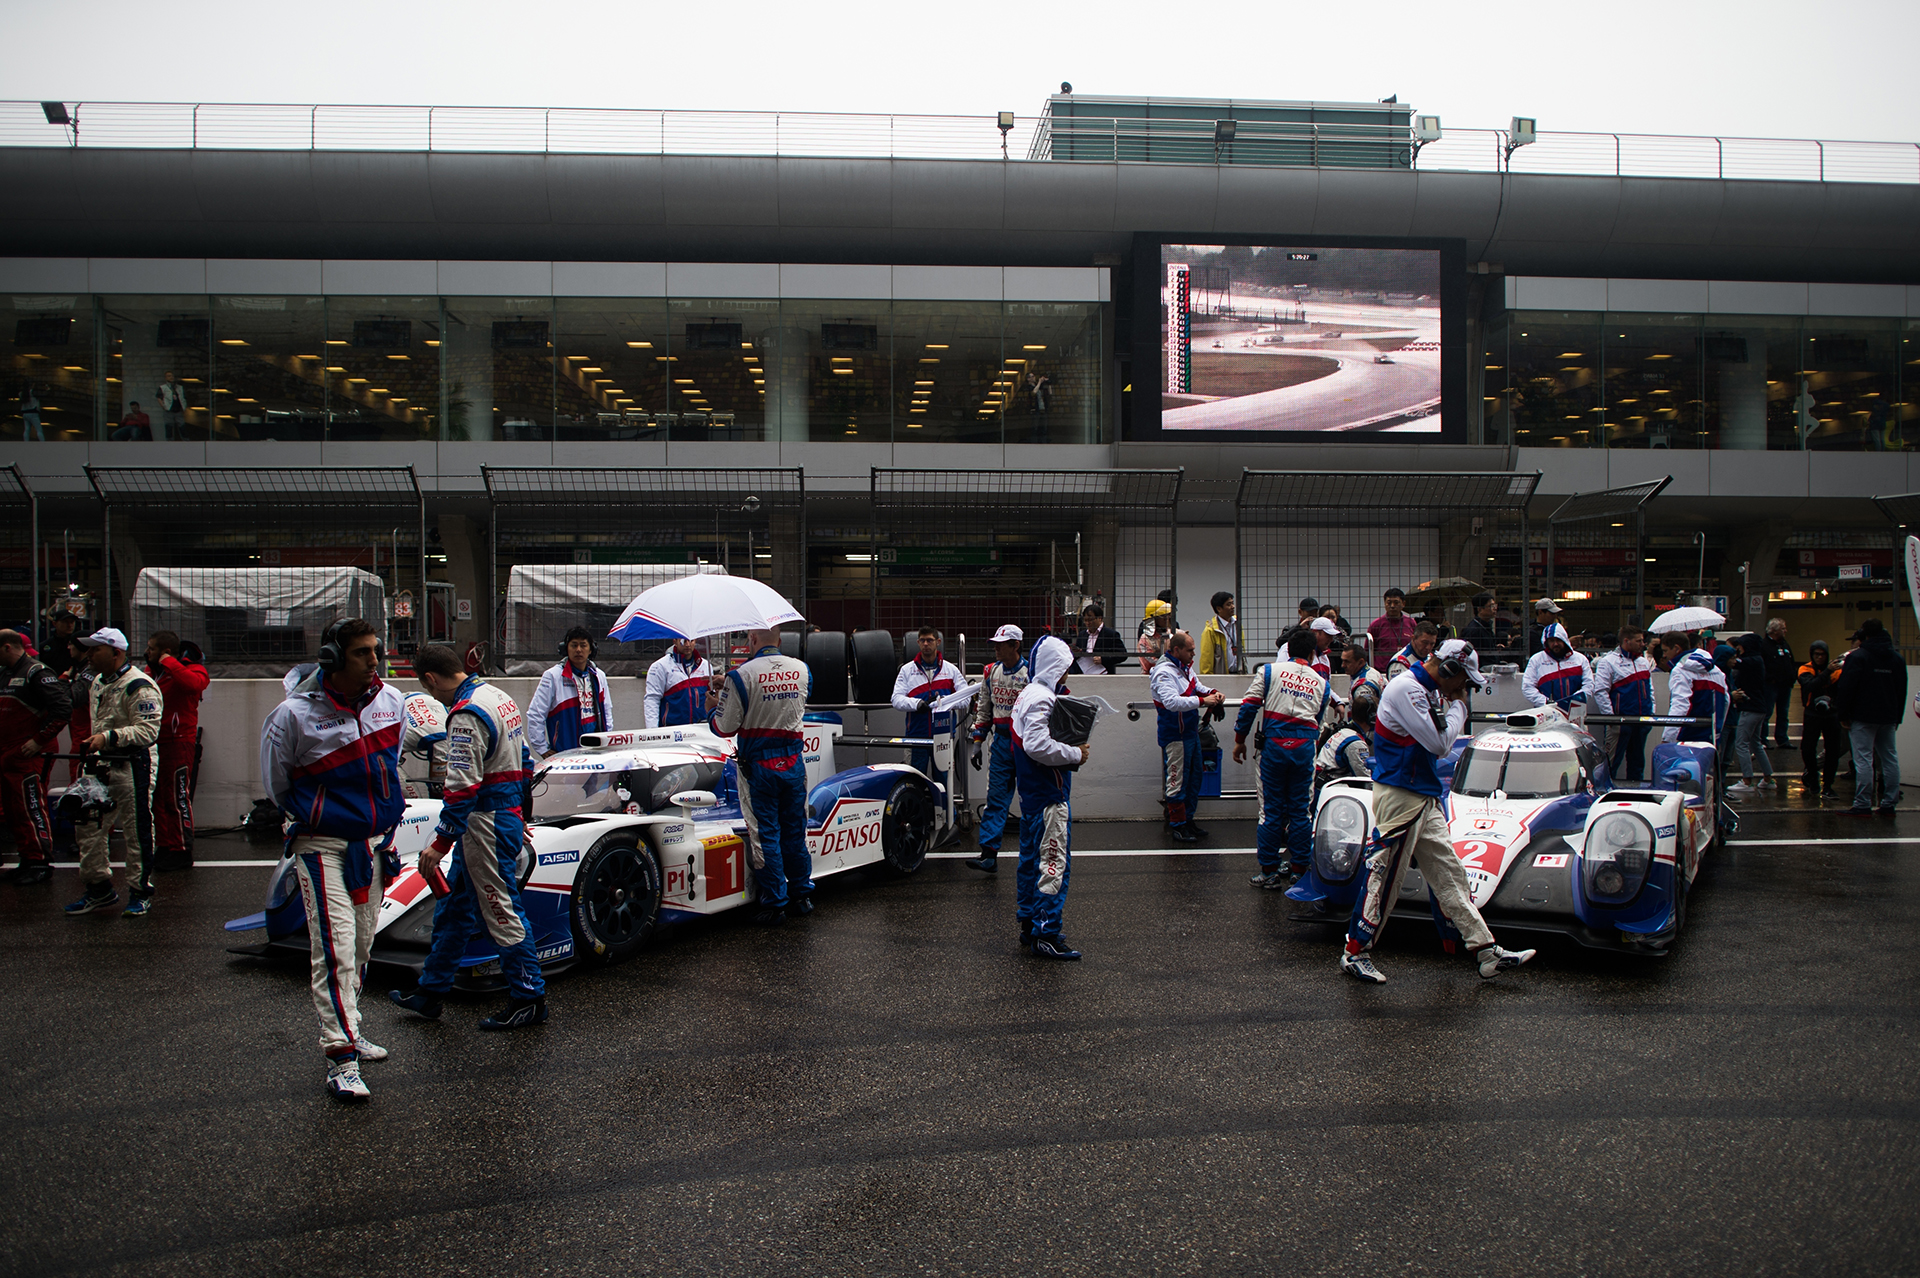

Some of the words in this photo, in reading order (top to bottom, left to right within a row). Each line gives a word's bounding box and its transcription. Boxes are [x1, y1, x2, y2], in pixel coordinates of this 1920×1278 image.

[265, 550, 278, 562] 83
[577, 552, 589, 561] 71
[883, 551, 894, 560] 51
[1532, 552, 1537, 560] 1
[1804, 554, 1810, 562] 2
[1864, 566, 1869, 577] 1
[67, 603, 84, 616] 72
[1719, 599, 1725, 613] 1
[759, 671, 800, 683] DENSO
[1280, 671, 1318, 687] DENSO
[762, 684, 799, 693] TOYOTA
[1282, 680, 1314, 695] TOYOTA
[1486, 686, 1492, 695] 6
[763, 692, 798, 701] HYBRID
[1280, 688, 1313, 700] HYBRID
[139, 702, 155, 711] FIA
[415, 698, 438, 726] DENSO
[407, 702, 424, 726] TOYOTA
[316, 721, 338, 731] Mobil
[607, 734, 634, 746] ZENT
[1472, 740, 1503, 748] TOYOTA
[936, 743, 948, 752] JTEKT
[28, 784, 38, 809] Sport
[630, 806, 637, 815] E
[34, 808, 44, 828] Audi
[416, 825, 419, 834] 1
[1659, 826, 1675, 837] AISIN
[709, 835, 735, 846] DHL
[821, 822, 880, 856] DENSO
[543, 852, 577, 863] AISIN
[1049, 838, 1058, 875] DENSO
[1461, 841, 1488, 868] 2
[1539, 856, 1562, 864] P1
[726, 850, 737, 889] 1
[668, 870, 684, 892] P1
[484, 885, 508, 925] DENSO
[1357, 920, 1376, 935] Mobil
[536, 943, 571, 959] HELIN
